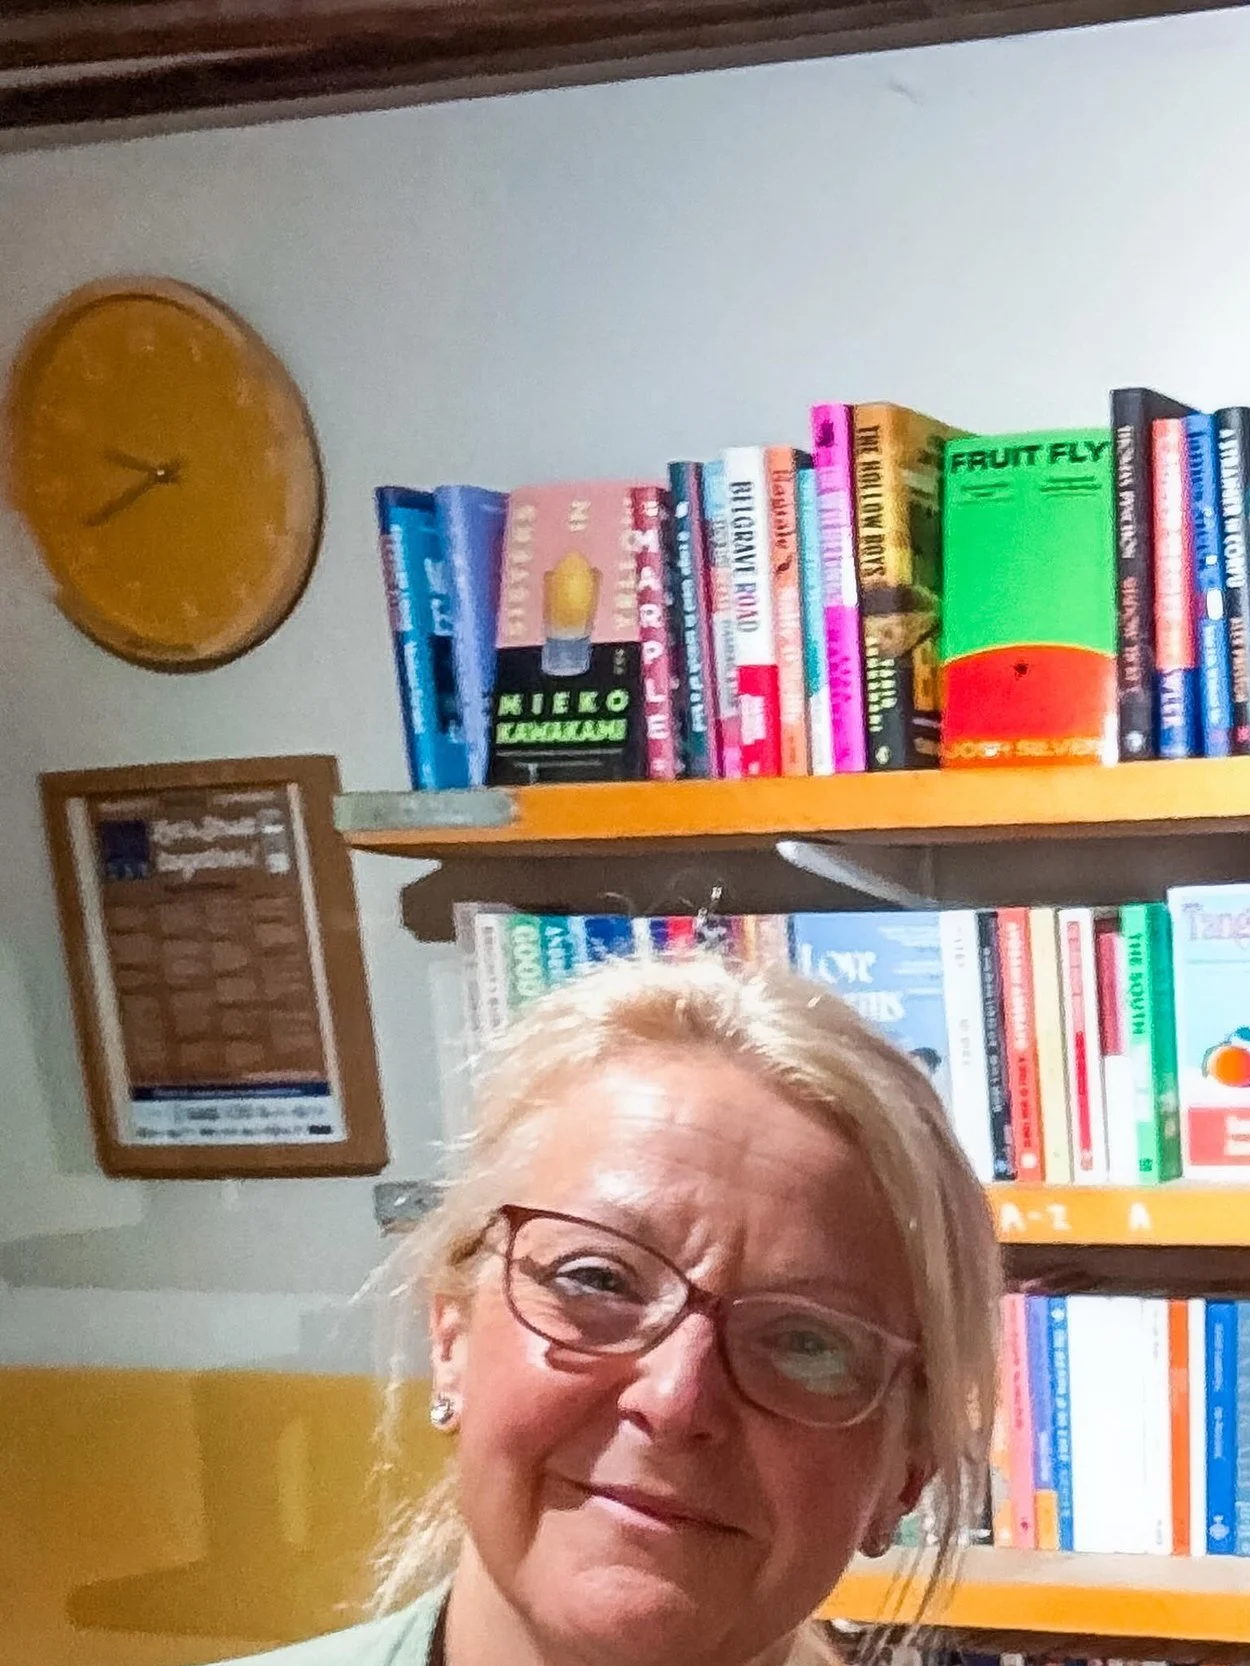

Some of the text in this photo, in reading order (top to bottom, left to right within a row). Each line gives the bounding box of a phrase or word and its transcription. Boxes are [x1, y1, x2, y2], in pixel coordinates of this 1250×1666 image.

[950, 440, 1109, 473] FRUIT FLY
[859, 426, 886, 577] THE HOLLOW BOYS
[730, 481, 760, 632] BELGRAVE ROAD
[497, 688, 629, 717] MIEKO
[1128, 932, 1145, 965] THE
[1001, 1202, 1071, 1232] A-Z
